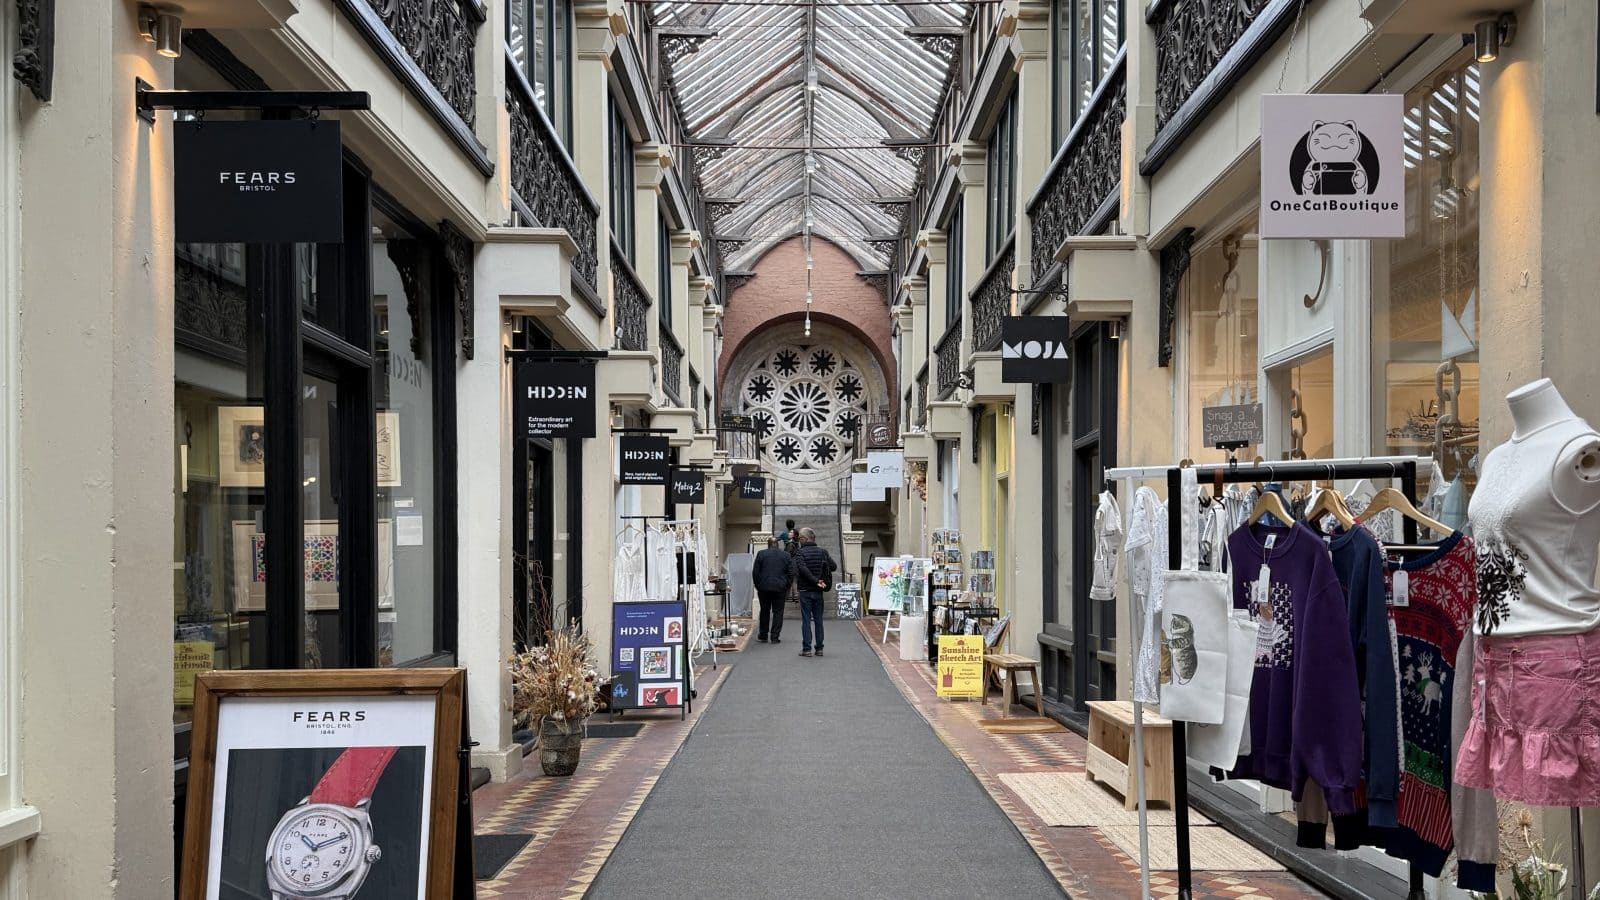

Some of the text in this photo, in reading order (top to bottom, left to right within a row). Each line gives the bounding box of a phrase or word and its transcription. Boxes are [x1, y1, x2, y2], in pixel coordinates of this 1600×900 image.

[220, 172, 296, 184] FEARS
[1270, 199, 1399, 213] OneCatBoutique
[1002, 340, 1069, 359] MOJA
[527, 386, 587, 399] HIDDEN
[1207, 410, 1245, 423] Snag a
[1206, 422, 1229, 435] snug
[625, 451, 664, 460] HIDDEN
[620, 626, 659, 636] HIDDEN
[942, 646, 980, 654] Sunshine
[939, 654, 982, 662] Sketch Art
[293, 711, 366, 722] FEARS
[302, 820, 310, 828] 11
[316, 819, 326, 827] 12
[290, 830, 300, 838] 10
[284, 843, 292, 851] 9
[339, 846, 348, 855] 3
[333, 860, 341, 868] 4
[290, 869, 297, 877] 7
[321, 871, 330, 879] 5
[303, 874, 311, 882] 6
